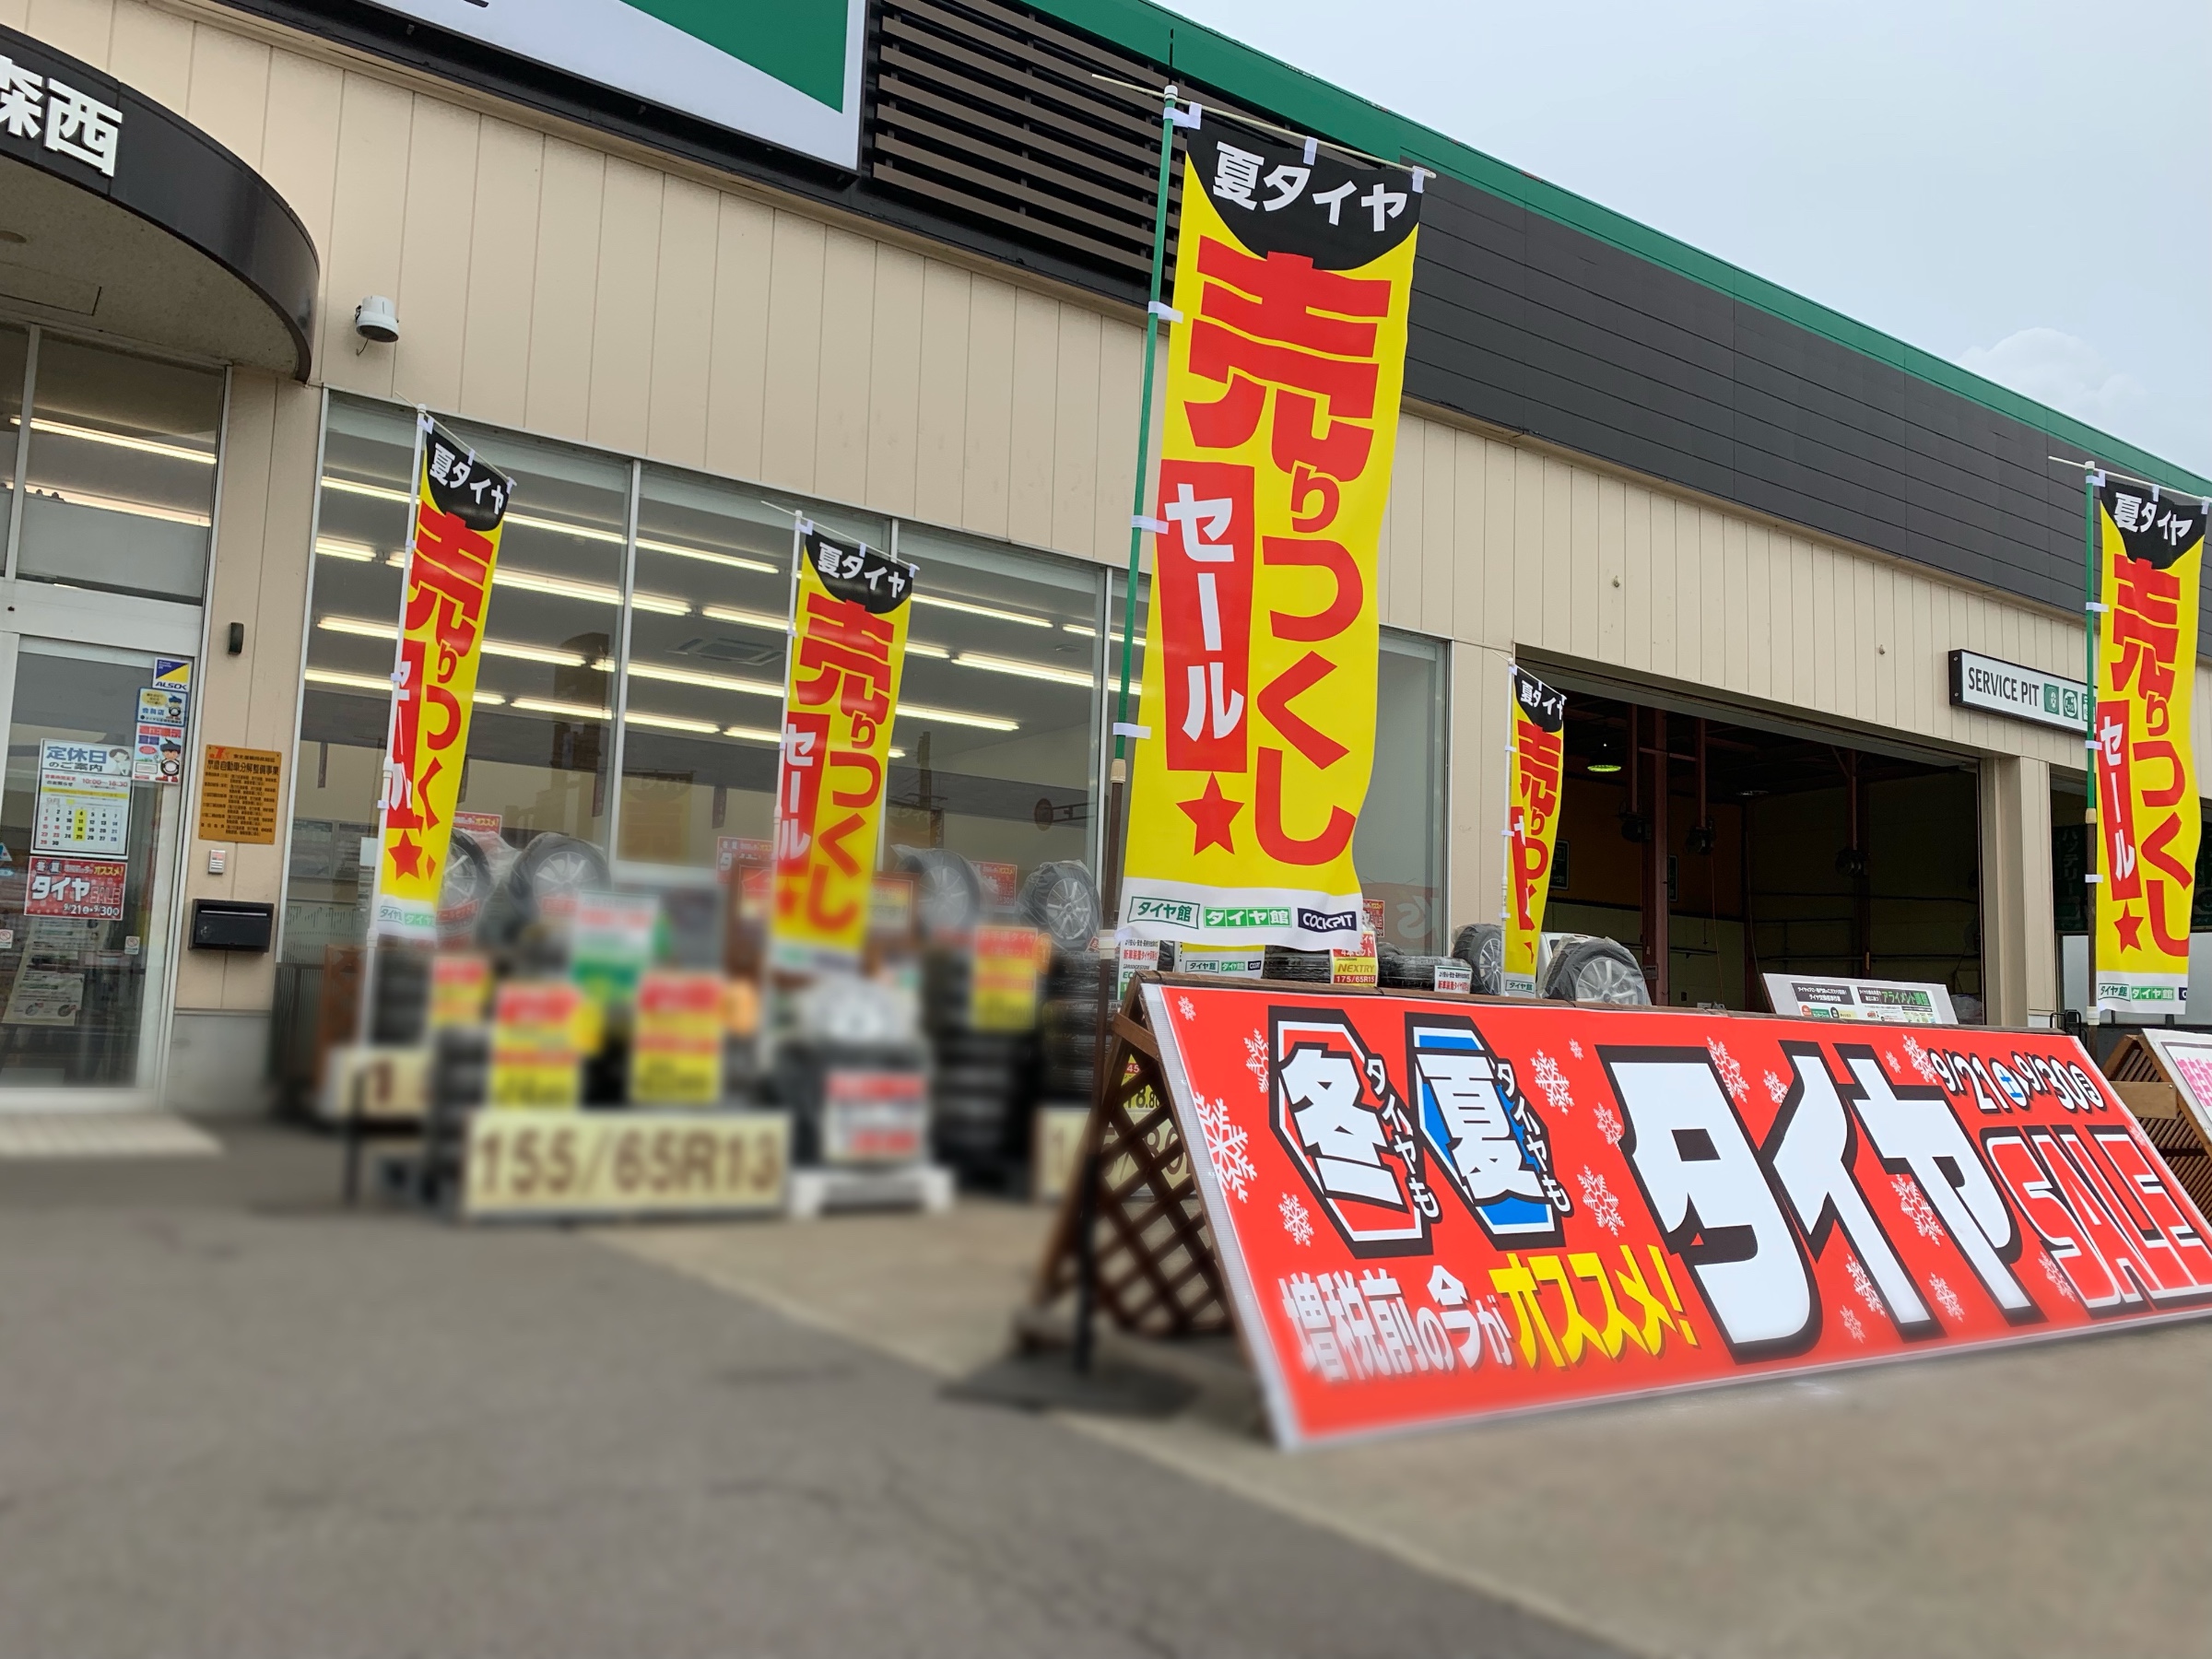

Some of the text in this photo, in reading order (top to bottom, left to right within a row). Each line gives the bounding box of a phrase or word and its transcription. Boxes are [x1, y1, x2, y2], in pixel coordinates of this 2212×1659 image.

[1212, 141, 1407, 232] 夏タイヤ
[431, 442, 505, 515] 夏タイヤ
[2113, 491, 2193, 547] 夏タイヤ
[818, 542, 906, 598] 夏タイヤ
[1183, 235, 1393, 865] 売りつくし
[1165, 483, 1244, 743] セール
[155, 681, 187, 690] ALSOK
[405, 500, 495, 879] 売りつく
[1968, 666, 2040, 708] SERVICE PIT
[46, 746, 107, 764] 定休日
[49, 761, 103, 772] のご案内
[777, 724, 817, 861] セール
[795, 592, 895, 932] 売りつくし
[2100, 715, 2136, 882] セール
[2111, 553, 2194, 957] 売りつくし
[31, 876, 90, 902] タイヤ
[1136, 900, 1353, 930] タイヤ館 タイヤ館 COCKPIT
[1335, 975, 1375, 983] 175/65R15
[1337, 963, 1375, 973] NEXTRY
[2099, 983, 2128, 998] タイヤ館
[2131, 987, 2174, 1001] タイヤ館
[1279, 1047, 1404, 1206] 冬
[1364, 1058, 1441, 1219] タイヤも
[1416, 1053, 1546, 1200] 夏
[1496, 1061, 1572, 1212] タイヤも
[1604, 1051, 2212, 1347] タイヤ SALE
